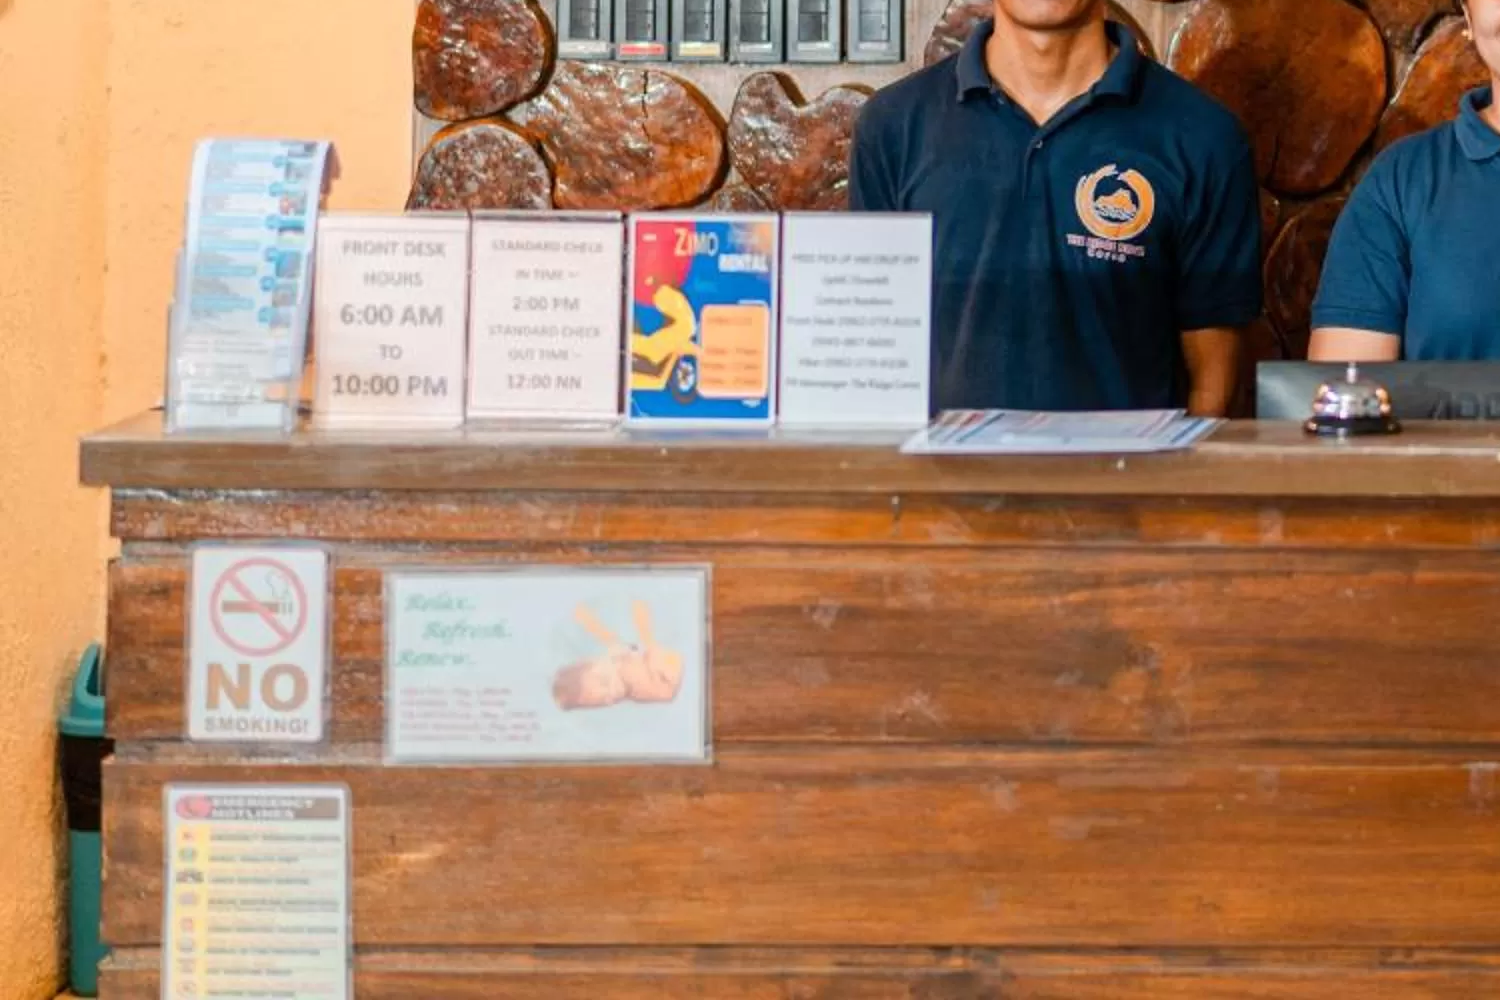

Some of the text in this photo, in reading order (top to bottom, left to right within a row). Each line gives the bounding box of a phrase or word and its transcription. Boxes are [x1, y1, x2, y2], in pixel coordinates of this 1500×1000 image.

[342, 240, 447, 258] FRONT DESK
[491, 240, 561, 253] STANDARD
[364, 271, 424, 287] HOURS
[533, 269, 564, 281] TIME
[512, 297, 581, 312] 2:00 PM
[340, 304, 444, 327] 6:00 AM
[488, 325, 601, 339] STANDARD CHECK
[379, 344, 403, 361] TO
[508, 349, 569, 361] OUT TIME
[332, 374, 448, 397] 10:00 PM
[506, 374, 583, 390] 12:00 NN
[204, 663, 310, 713] NO
[203, 716, 310, 733] SMOKING!
